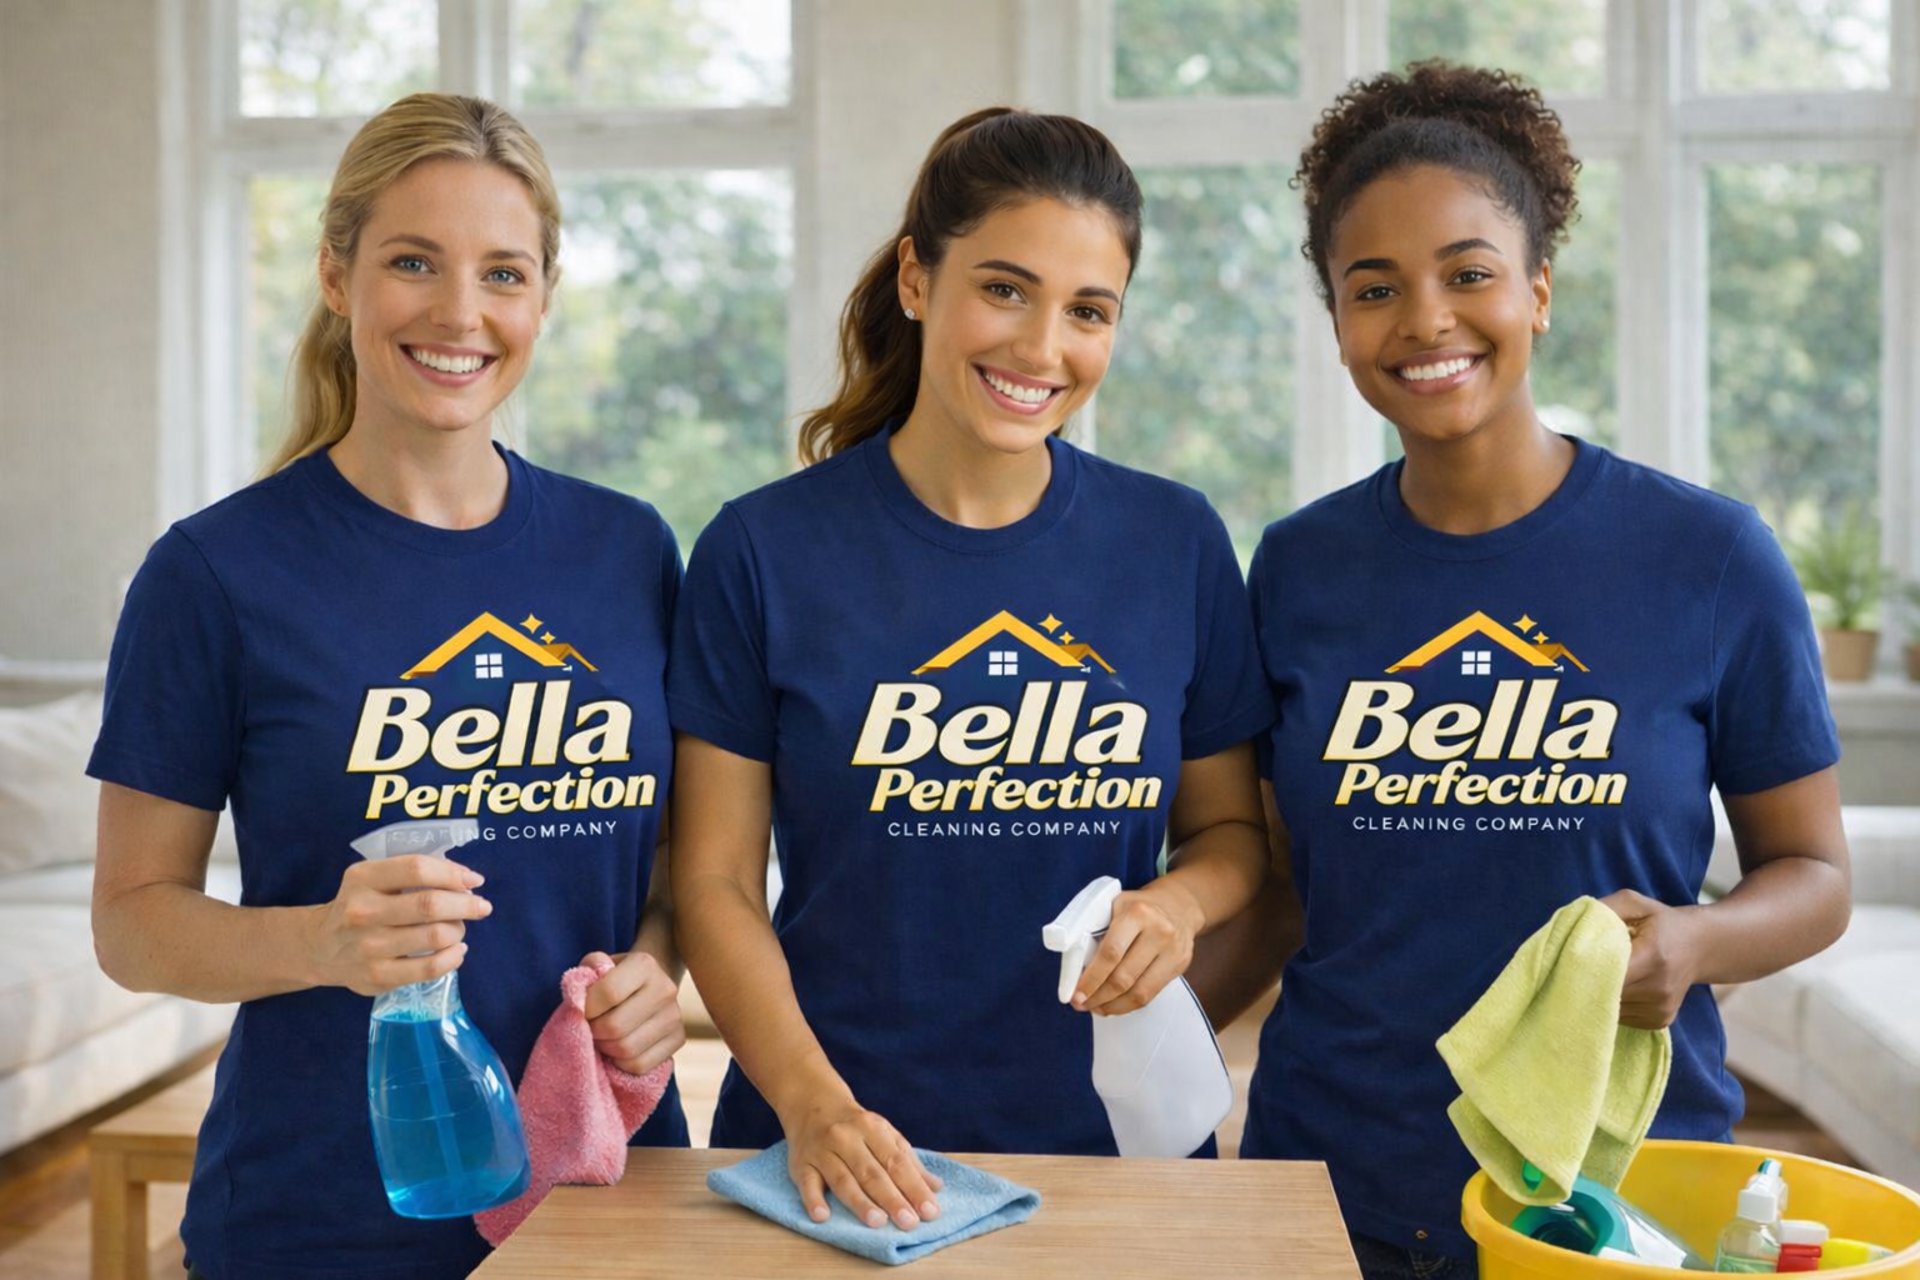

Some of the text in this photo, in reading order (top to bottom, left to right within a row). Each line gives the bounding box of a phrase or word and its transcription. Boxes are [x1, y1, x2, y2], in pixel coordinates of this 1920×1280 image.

[345, 679, 633, 772] Bella
[851, 680, 1148, 766] Bella
[1322, 678, 1619, 761] Bella
[365, 766, 657, 819] Perfection
[869, 766, 1162, 812] Perfection
[1334, 760, 1628, 806] Perfection
[506, 820, 618, 841] COMPANY
[887, 821, 1121, 837] CLEANING COMPANY
[1352, 816, 1586, 831] CLEANING COMPANY
